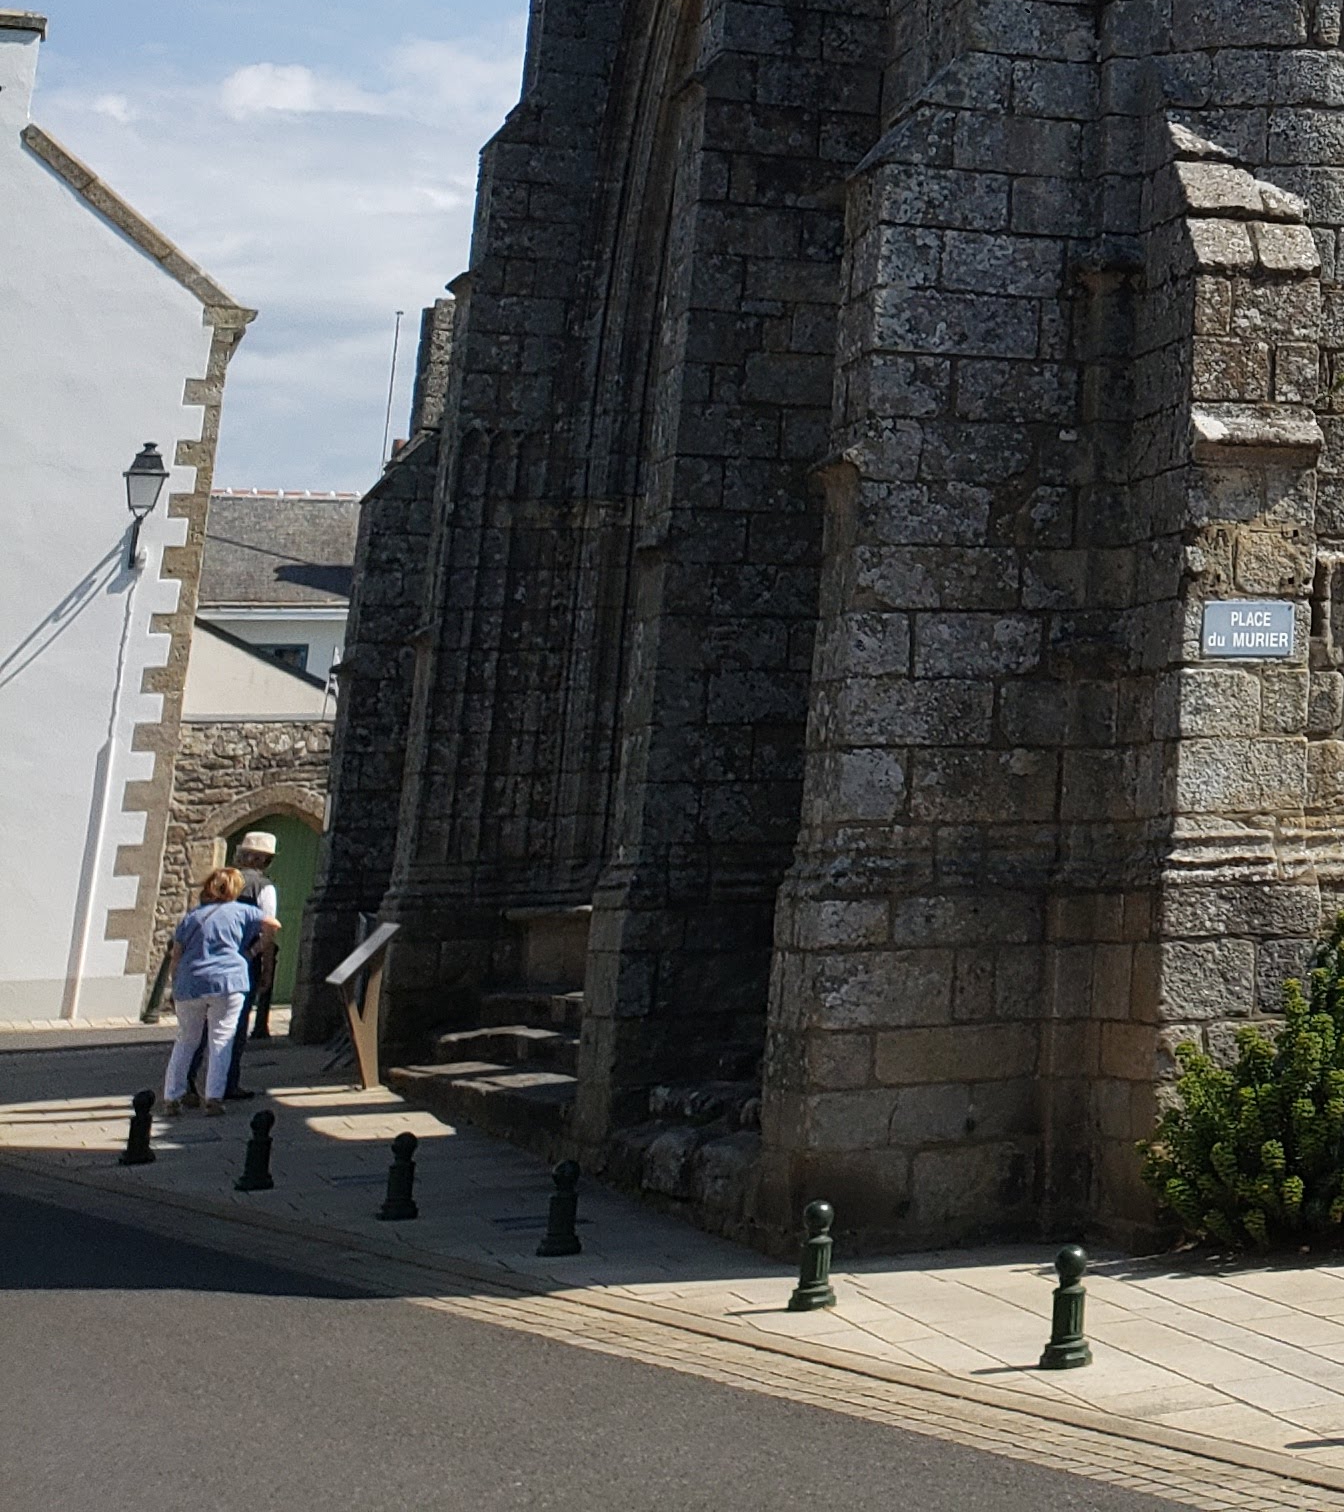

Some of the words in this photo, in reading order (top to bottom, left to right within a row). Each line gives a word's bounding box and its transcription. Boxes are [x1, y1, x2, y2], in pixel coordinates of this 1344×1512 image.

[1231, 611, 1272, 626] PLACE
[1208, 632, 1225, 647] du
[1233, 632, 1289, 647] MURIER
